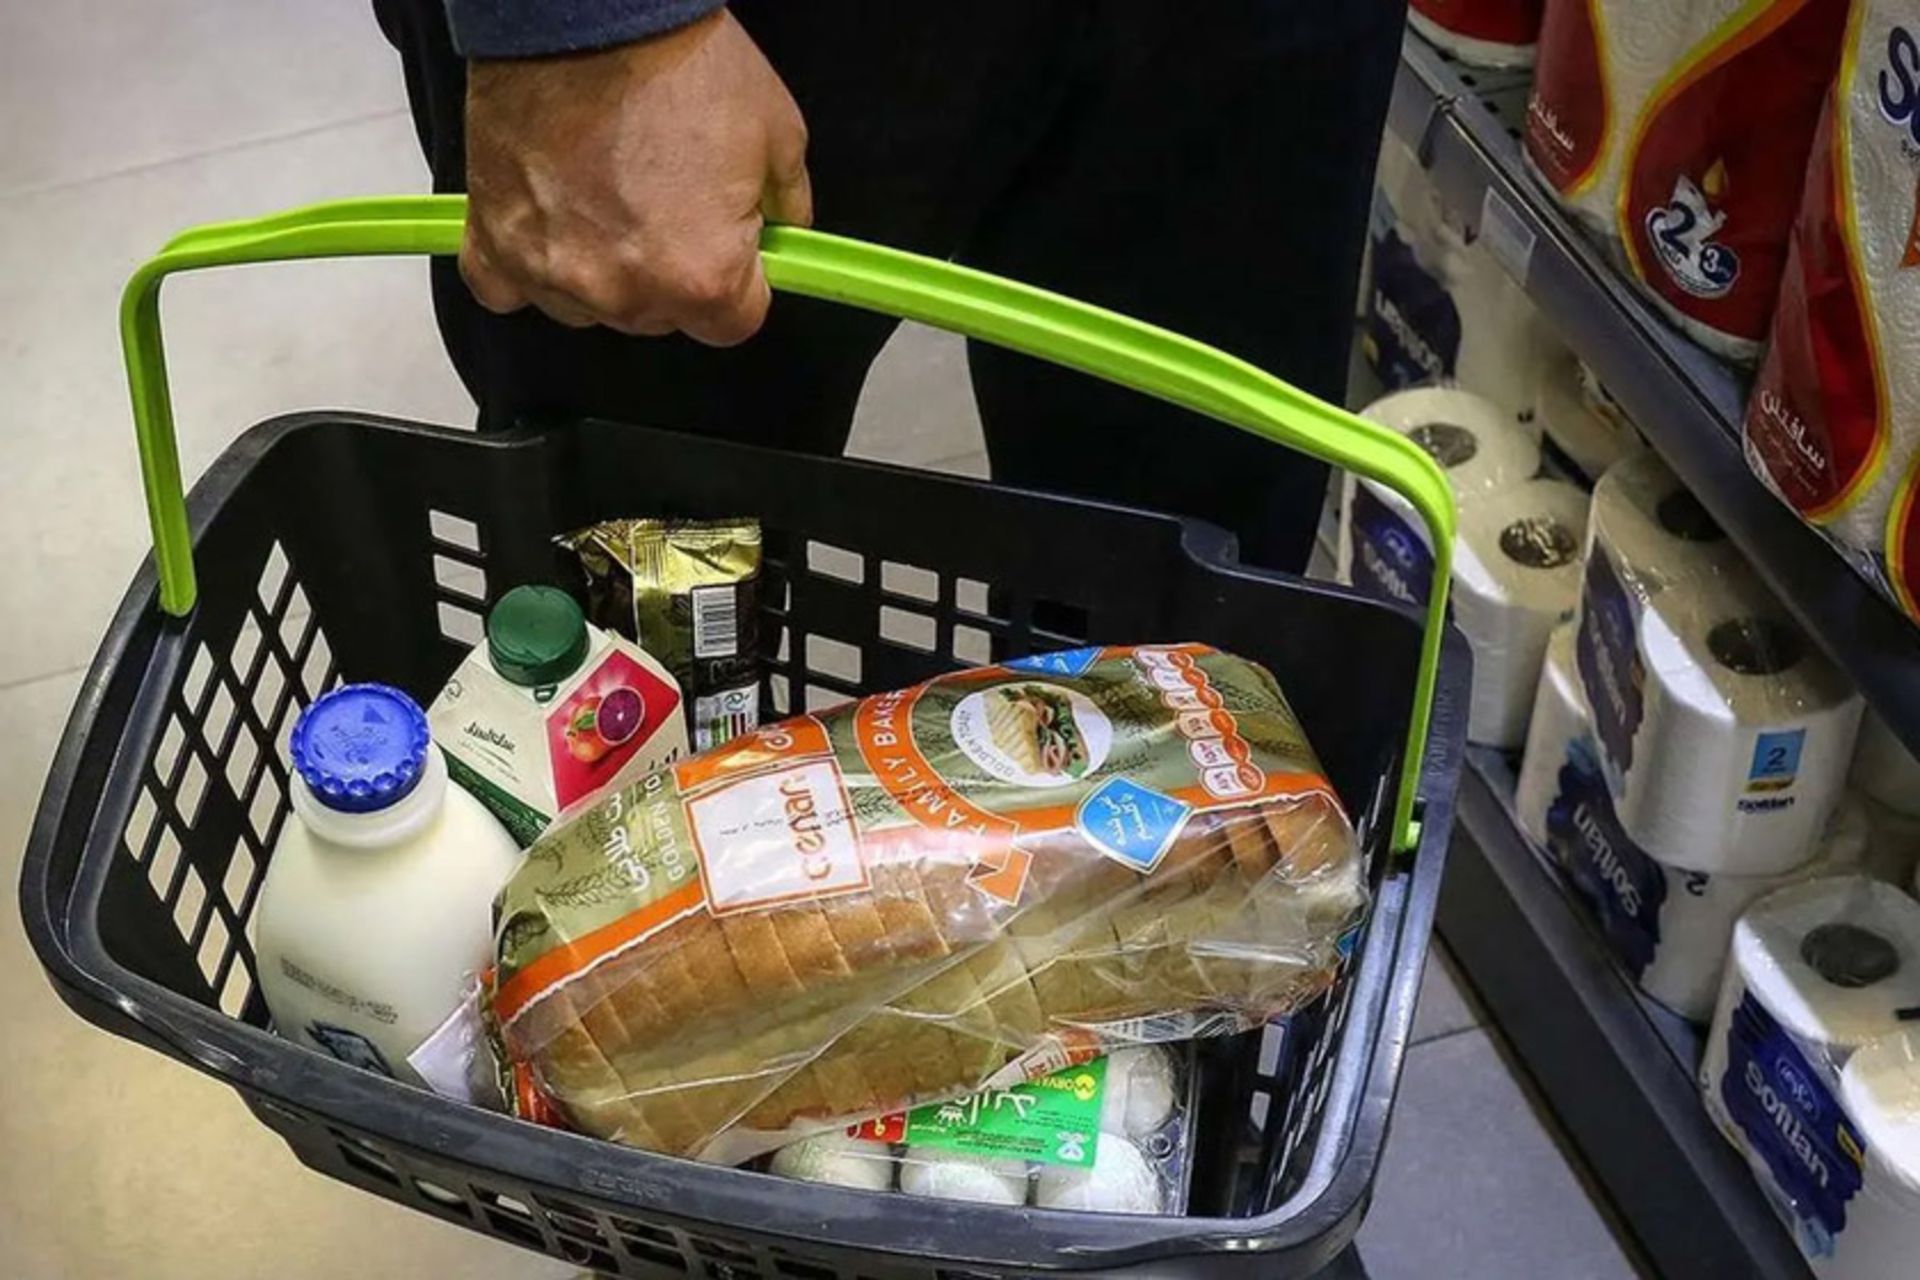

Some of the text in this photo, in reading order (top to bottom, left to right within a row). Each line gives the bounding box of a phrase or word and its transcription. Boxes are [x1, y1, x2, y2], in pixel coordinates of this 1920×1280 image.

[1702, 248, 1719, 273] 3
[1768, 747, 1787, 766] 2
[882, 757, 987, 835] FAMILY
[1573, 806, 1639, 916] Softlan
